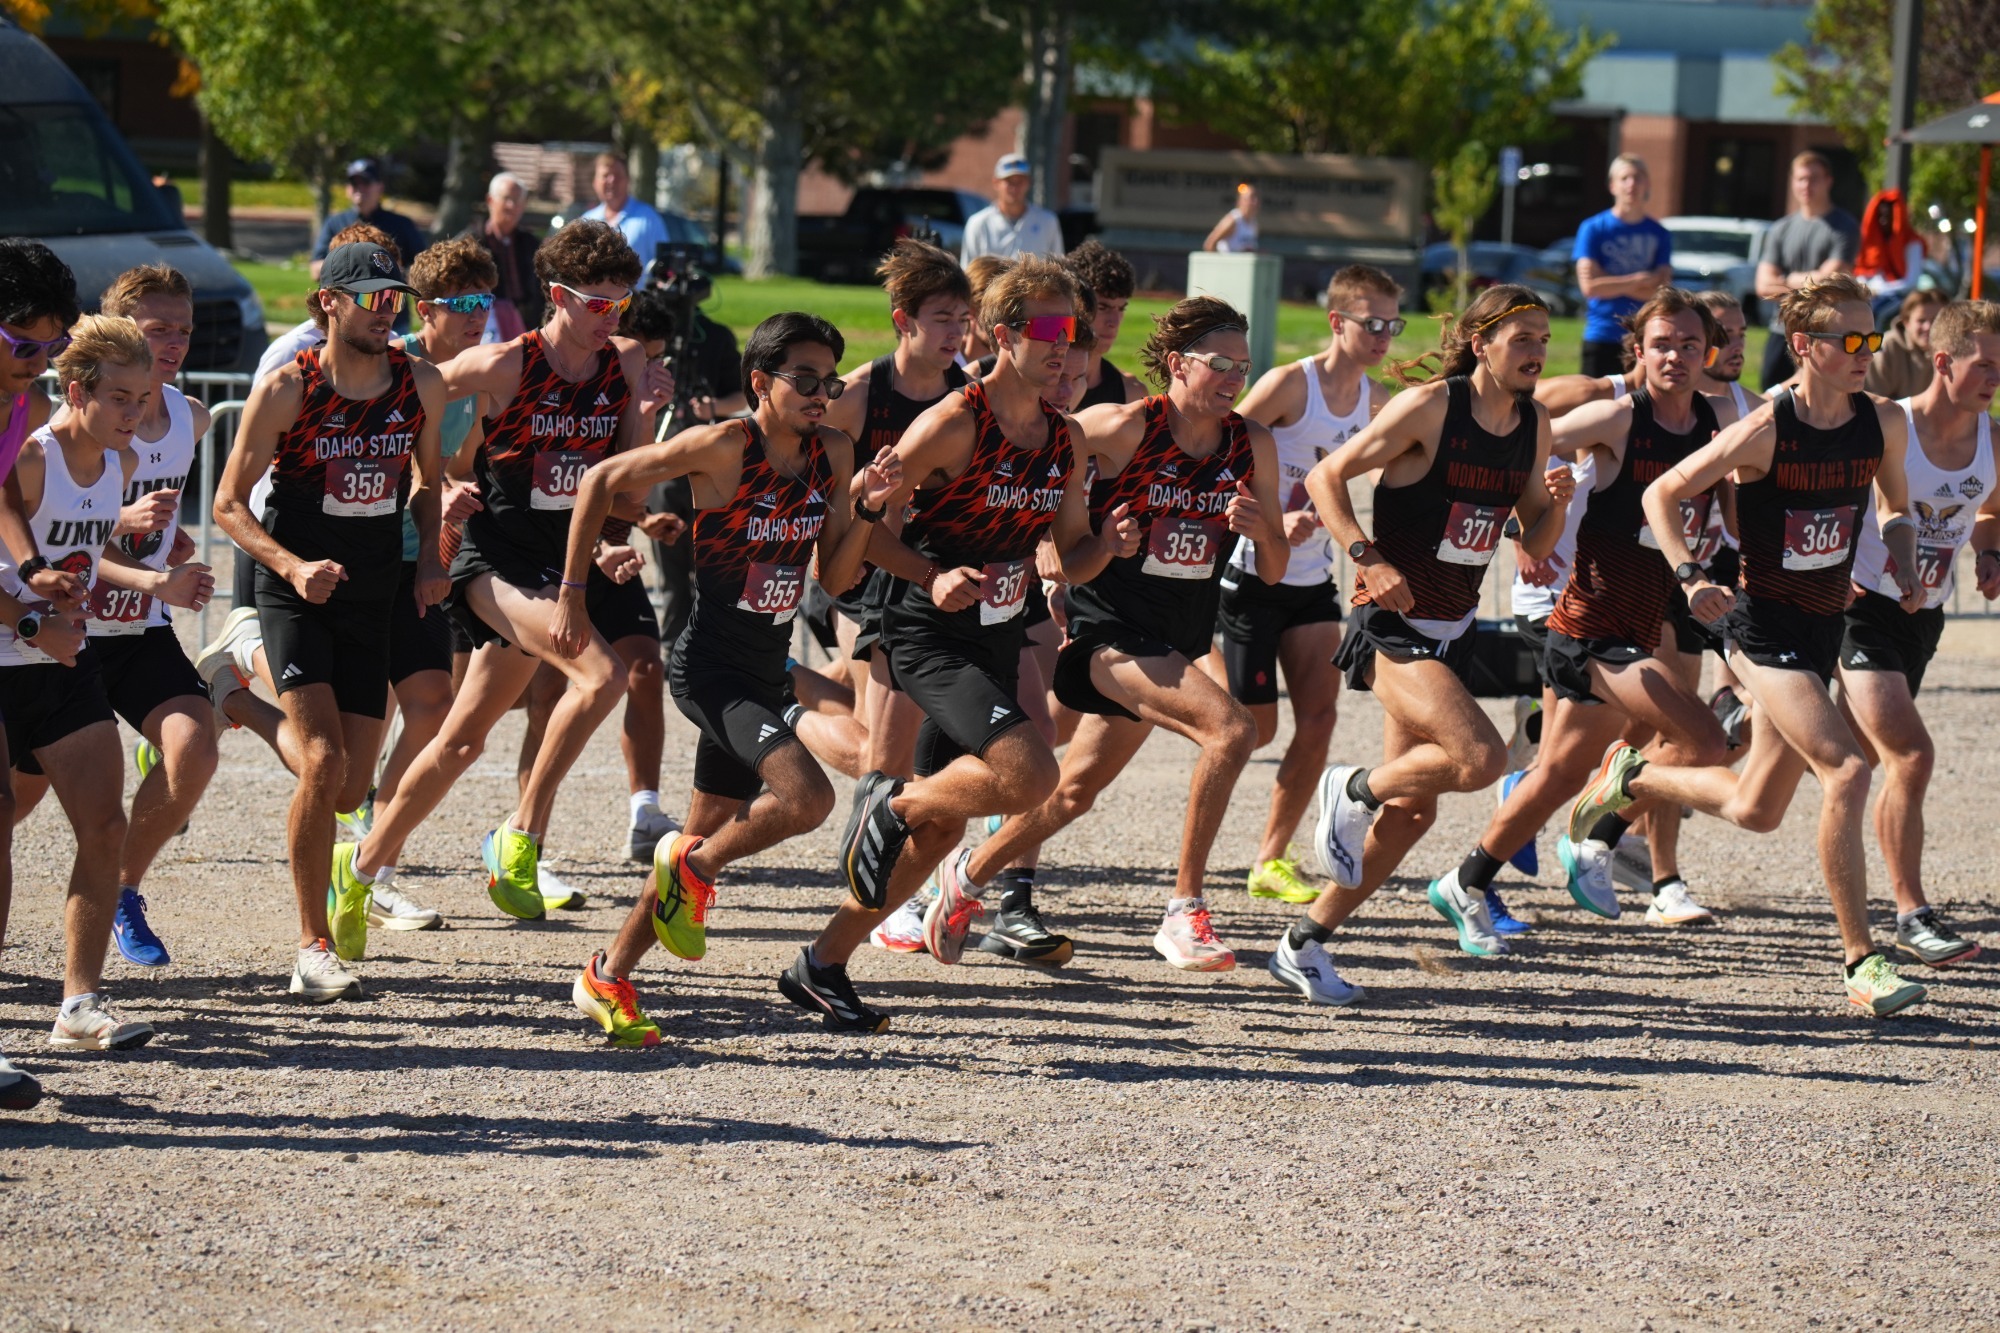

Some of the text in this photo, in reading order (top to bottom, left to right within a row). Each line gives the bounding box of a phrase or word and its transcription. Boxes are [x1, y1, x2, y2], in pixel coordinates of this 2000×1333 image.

[548, 393, 559, 401] SKY
[331, 413, 344, 423] SKY
[531, 414, 619, 438] IDAHO STATE
[315, 433, 413, 460] IDAHO STATE
[1001, 462, 1011, 471] SKY
[1166, 464, 1177, 472] SKY
[1447, 461, 1505, 492] MONTANA
[1776, 460, 1846, 491] MONTANA
[342, 472, 386, 500] 358
[763, 494, 776, 503] SKY
[986, 485, 1028, 510] IDAHO
[1147, 483, 1239, 513] IDAHO STAT
[1960, 483, 1983, 493] RMAC
[46, 519, 116, 546] UMW
[746, 514, 825, 542] IDAHO STATE
[1458, 518, 1495, 548] 371
[1802, 521, 1841, 553] 366
[1164, 532, 1208, 562] 353
[758, 579, 800, 608] 355
[993, 570, 1026, 604] 357
[102, 589, 143, 618] 373
